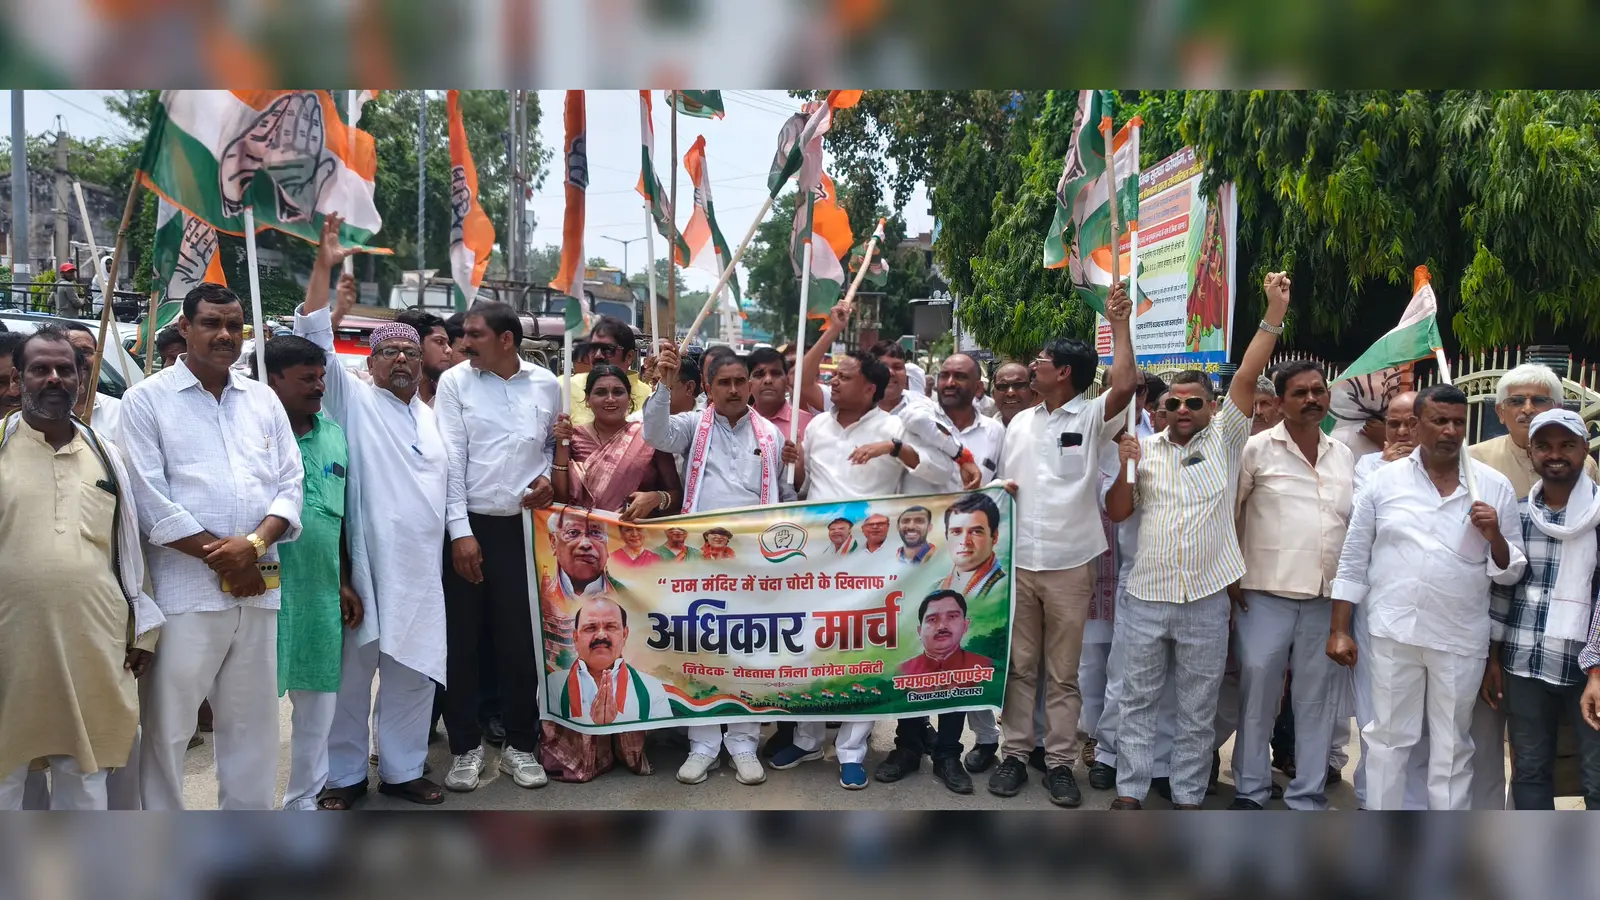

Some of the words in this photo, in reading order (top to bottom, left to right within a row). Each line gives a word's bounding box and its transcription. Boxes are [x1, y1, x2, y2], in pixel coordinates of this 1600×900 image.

[671, 579, 698, 593] राम
[701, 574, 738, 592] मंदिर
[741, 574, 757, 592] में
[758, 575, 783, 591] चंदा
[785, 572, 815, 590] चोरी
[817, 571, 831, 590] के
[834, 571, 886, 590] खिलाफ
[646, 598, 807, 655] अधिकार
[812, 590, 903, 650] मार्च
[733, 665, 775, 679] रोहतास
[778, 665, 808, 679] जिला
[811, 662, 846, 677] कांग्रेस
[848, 660, 884, 675] कमिटी
[892, 672, 952, 689] जयप्रकाश
[952, 664, 994, 684] पाण्डेय
[951, 687, 983, 698] रोहतास
